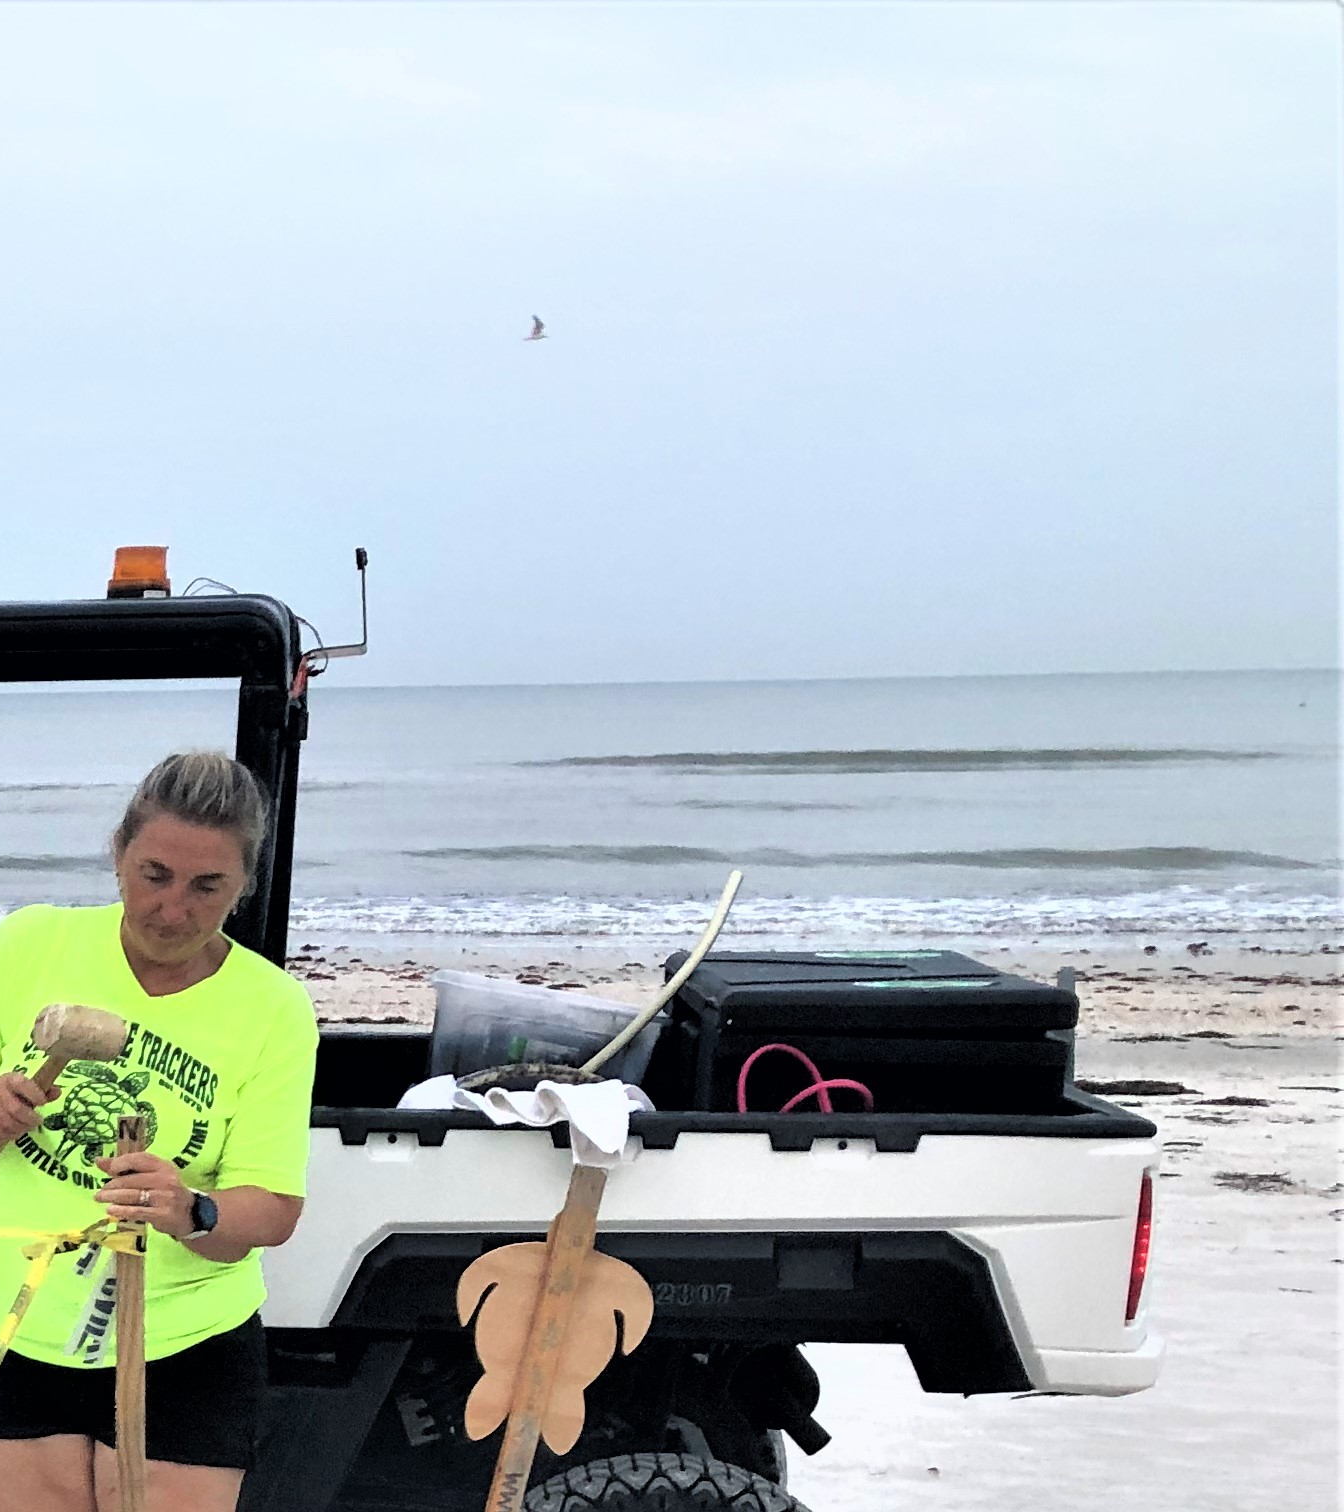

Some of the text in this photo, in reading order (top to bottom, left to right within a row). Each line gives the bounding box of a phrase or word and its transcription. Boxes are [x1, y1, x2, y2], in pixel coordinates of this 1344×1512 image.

[138, 1029, 219, 1109] TRACKERS
[15, 1132, 69, 1181] URTLES
[181, 1118, 209, 1158] TIME
